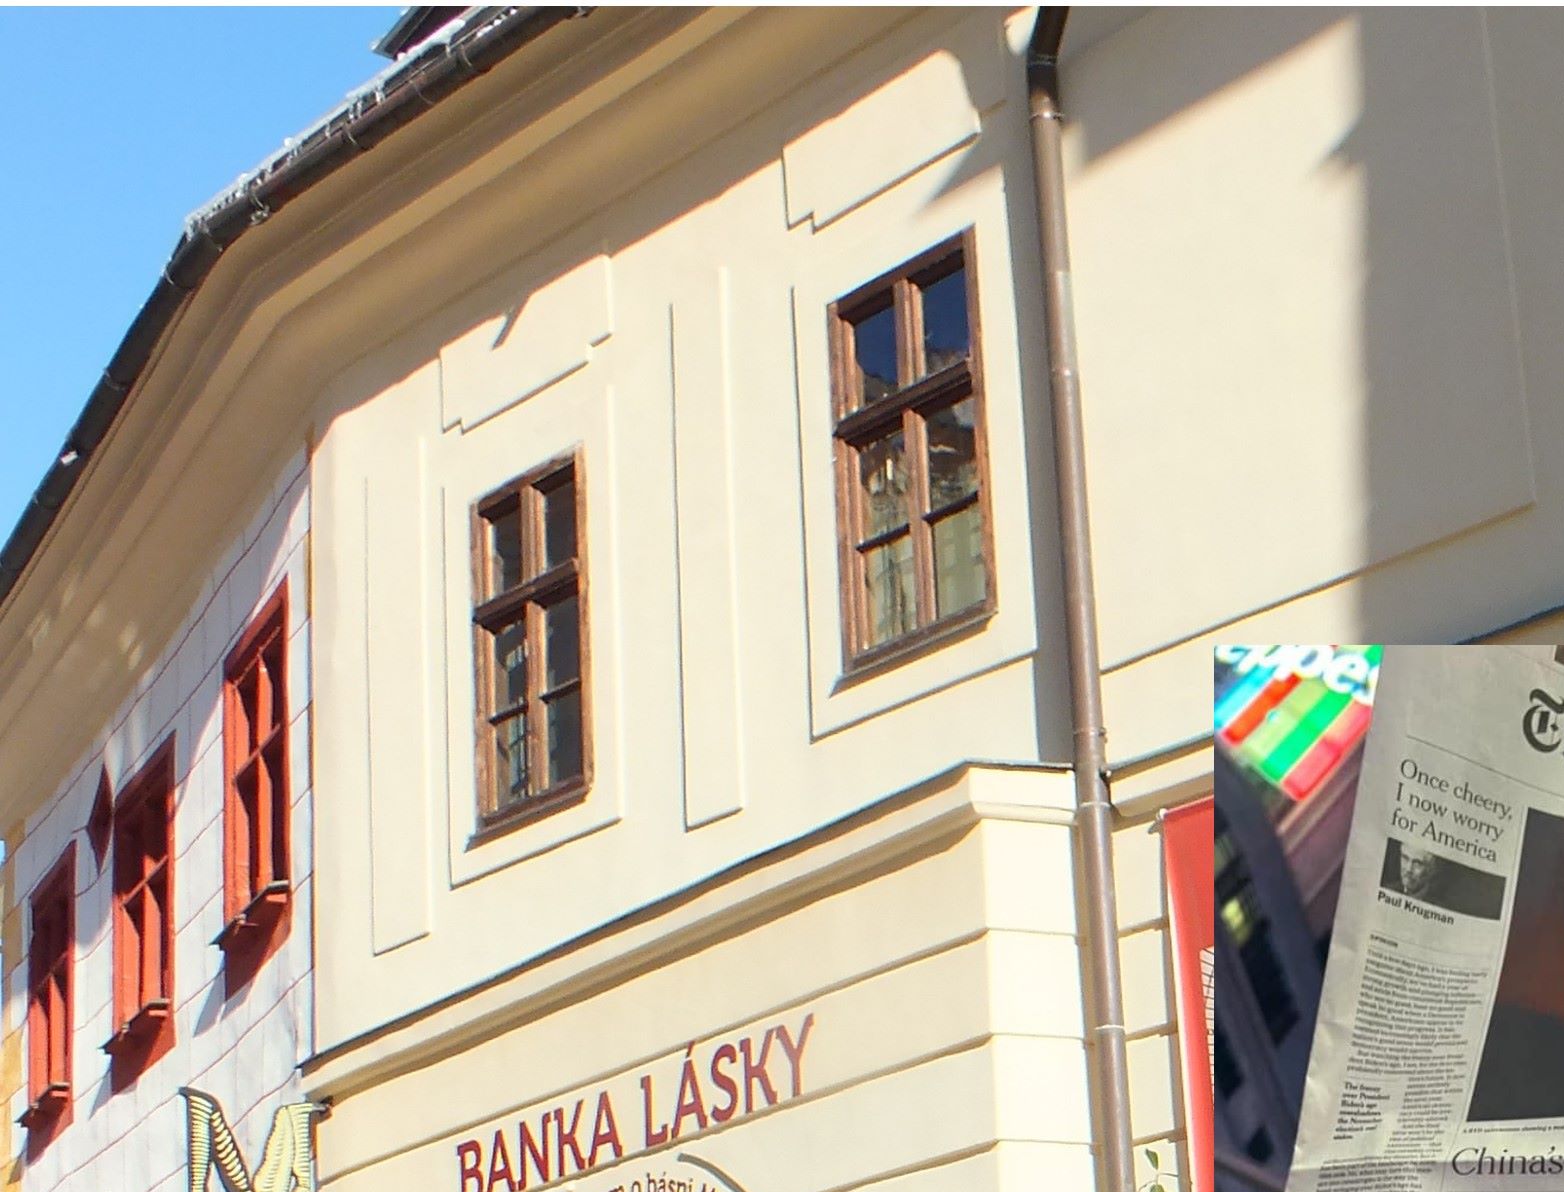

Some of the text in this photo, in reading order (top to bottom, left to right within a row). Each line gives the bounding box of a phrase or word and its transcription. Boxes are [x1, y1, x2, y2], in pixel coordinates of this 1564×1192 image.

[1396, 782, 1504, 842] I now worry
[1400, 758, 1513, 821] Once cheery,
[1391, 807, 1498, 863] for America
[1377, 890, 1455, 926] Paul Krugman
[640, 1012, 814, 1148] LÁSKY
[1451, 1145, 1564, 1177] China's
